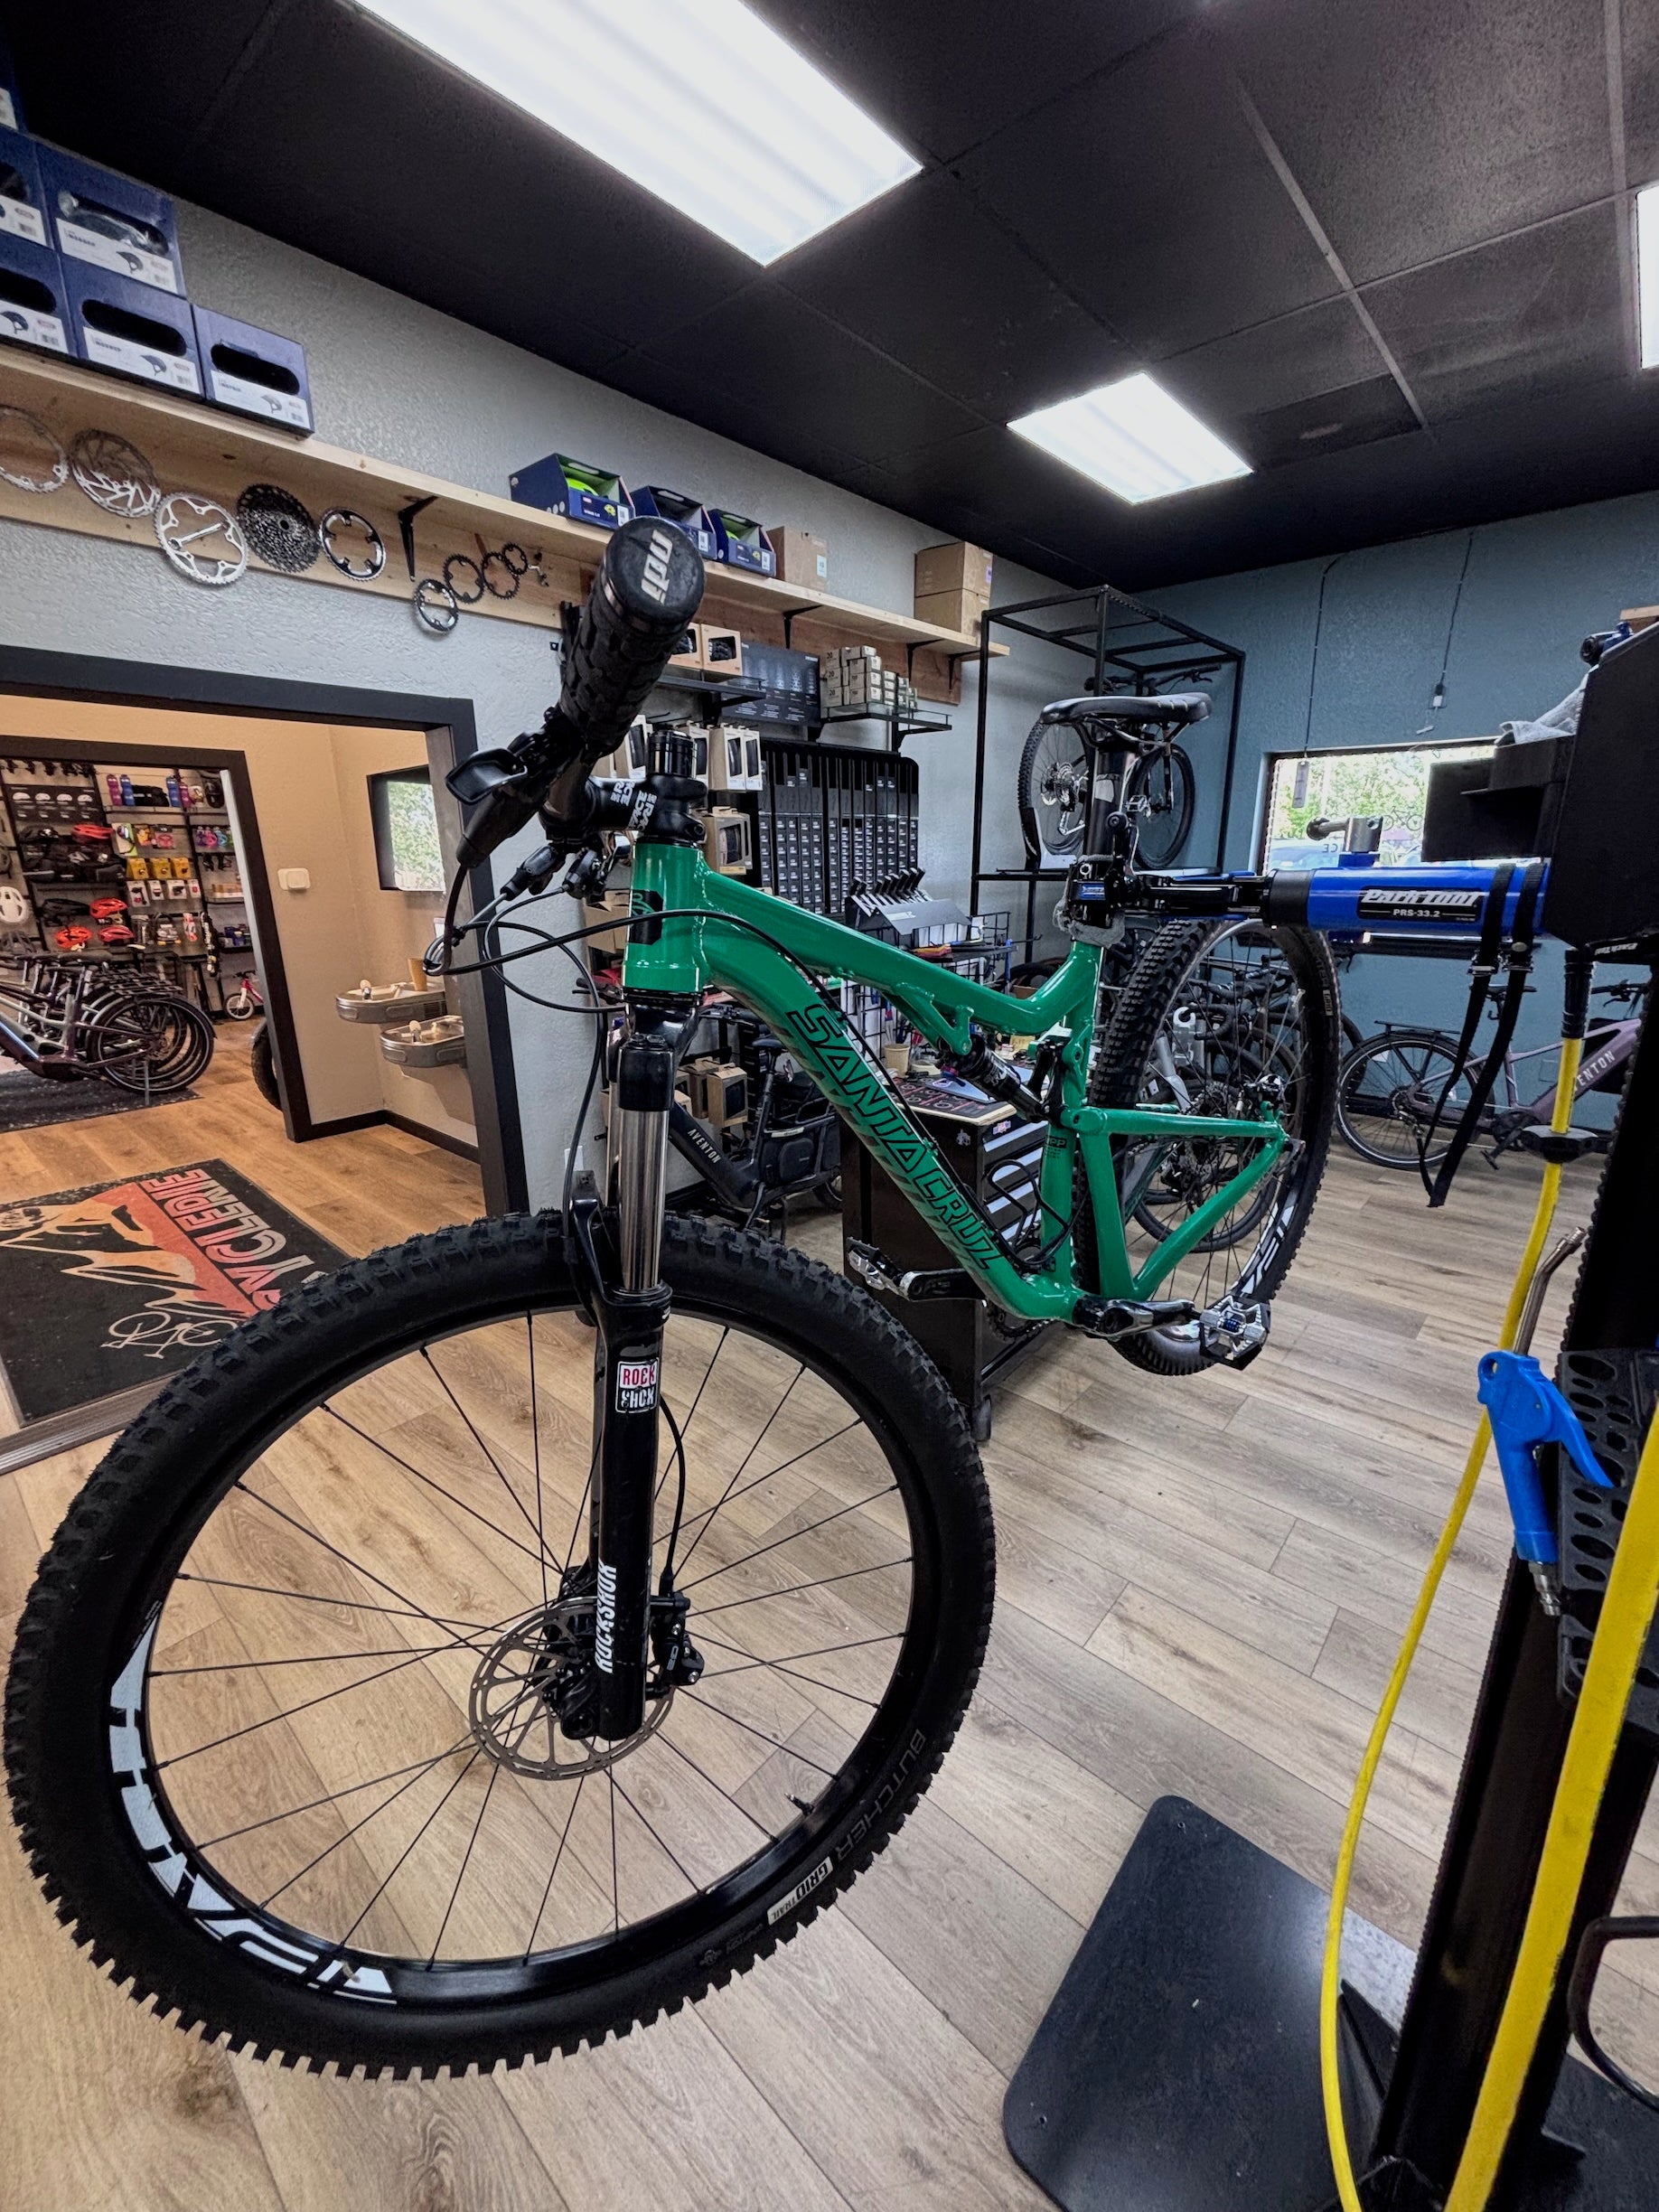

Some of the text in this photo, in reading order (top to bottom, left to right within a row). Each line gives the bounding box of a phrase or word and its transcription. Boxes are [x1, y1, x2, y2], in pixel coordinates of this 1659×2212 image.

[1392, 909, 1440, 917] PRS-33.2
[1575, 1050, 1616, 1091] ENTON
[687, 1129, 722, 1164] AVENTON
[786, 1004, 1004, 1270] SANTA CRUZ
[623, 1363, 657, 1385] ROCK
[621, 1387, 654, 1408] SHOX
[595, 1557, 617, 1674] ROCKSHOX
[836, 1729, 926, 1861] BUTCHER
[772, 1861, 829, 1921] GRID TRAIL
